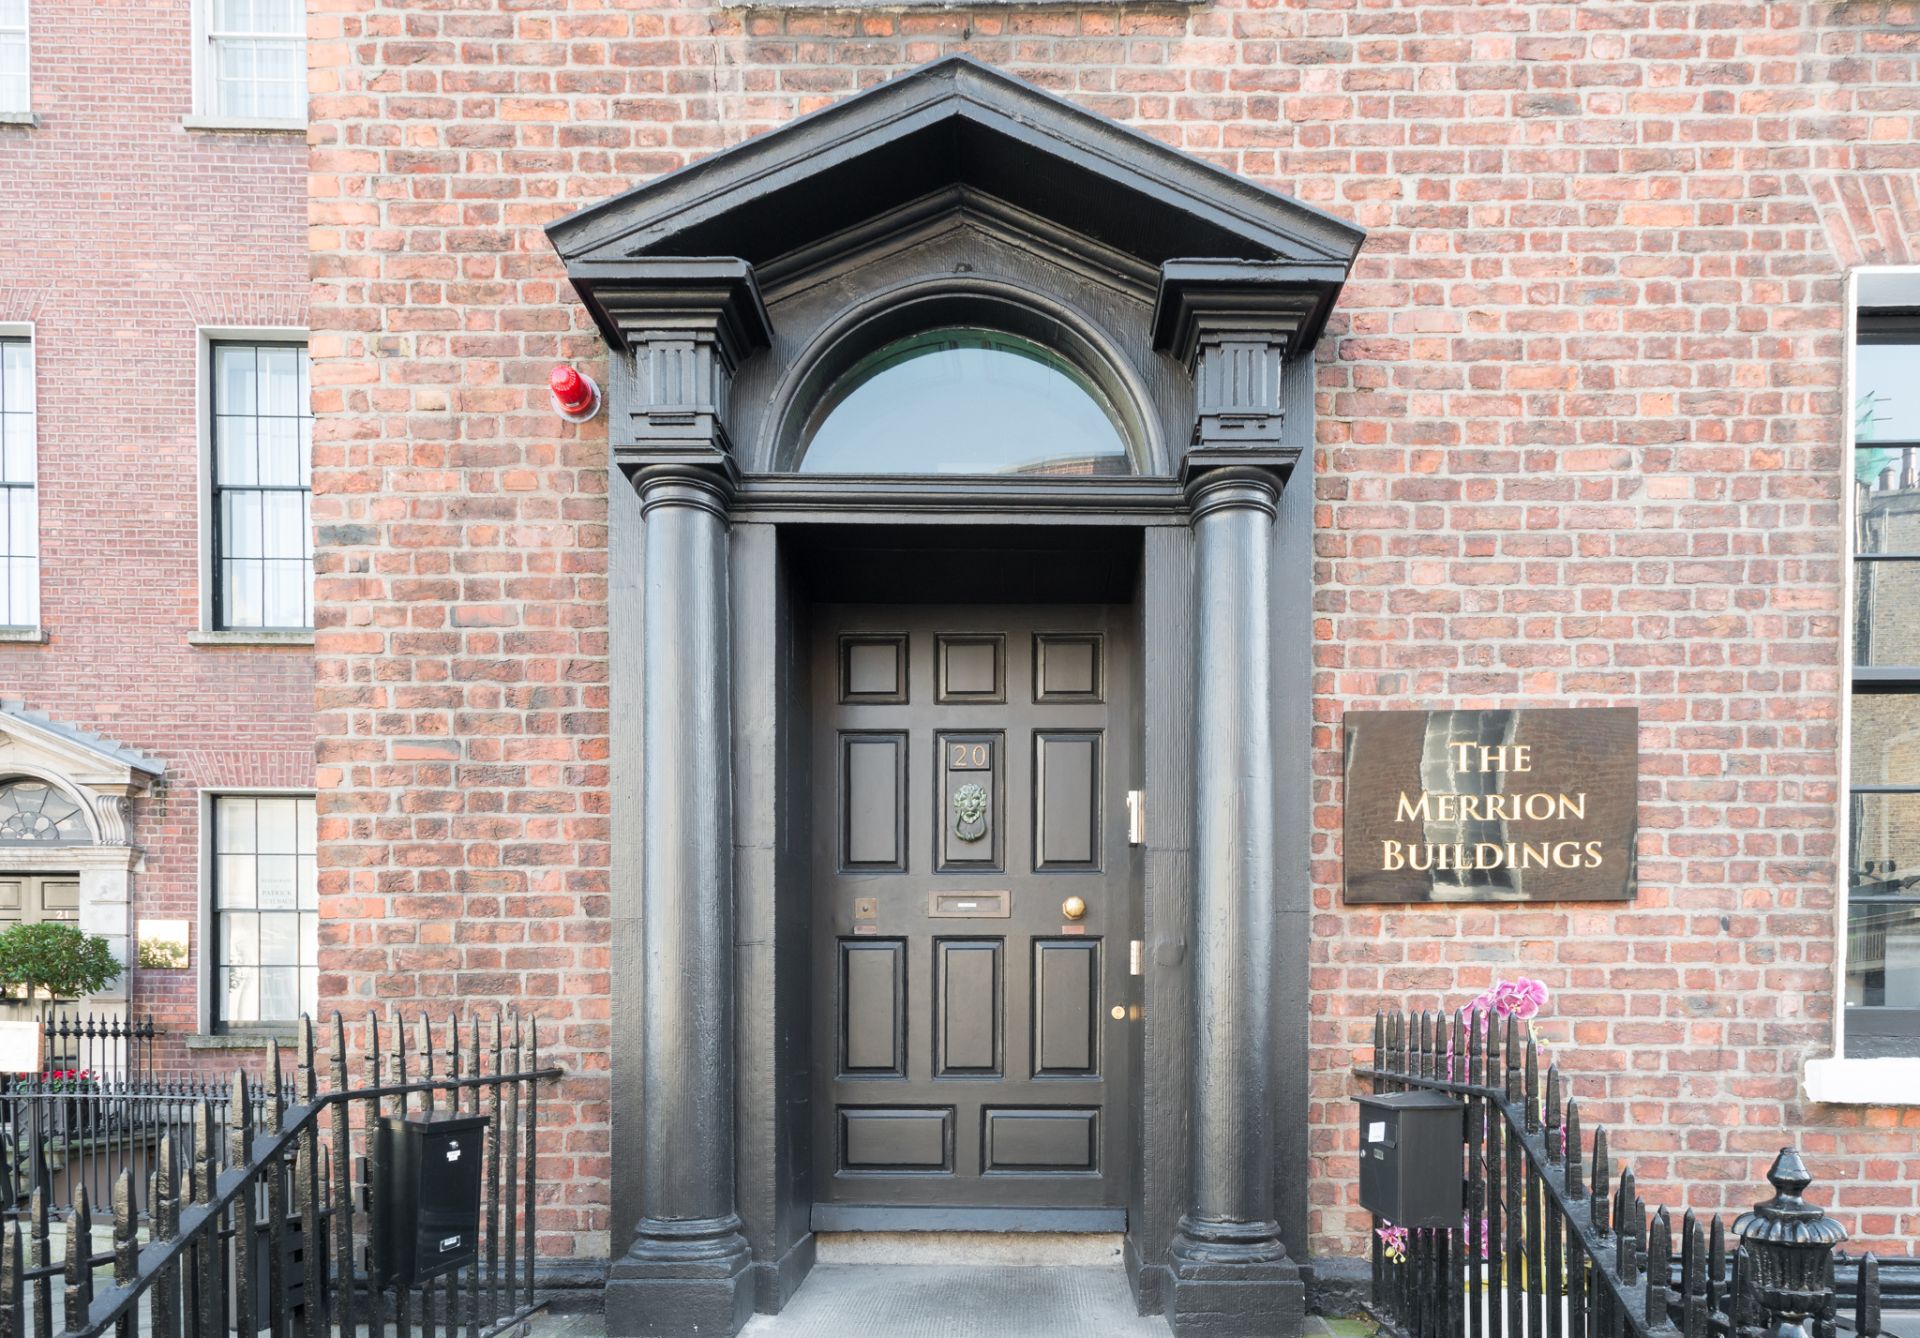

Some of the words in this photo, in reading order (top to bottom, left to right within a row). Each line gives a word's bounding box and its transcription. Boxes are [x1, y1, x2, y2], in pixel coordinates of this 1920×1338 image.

[953, 744, 986, 767] 20
[1450, 741, 1532, 773] THE
[1394, 791, 1587, 822] MERRION
[1381, 840, 1603, 871] BUILDINGS
[55, 910, 69, 919] 21
